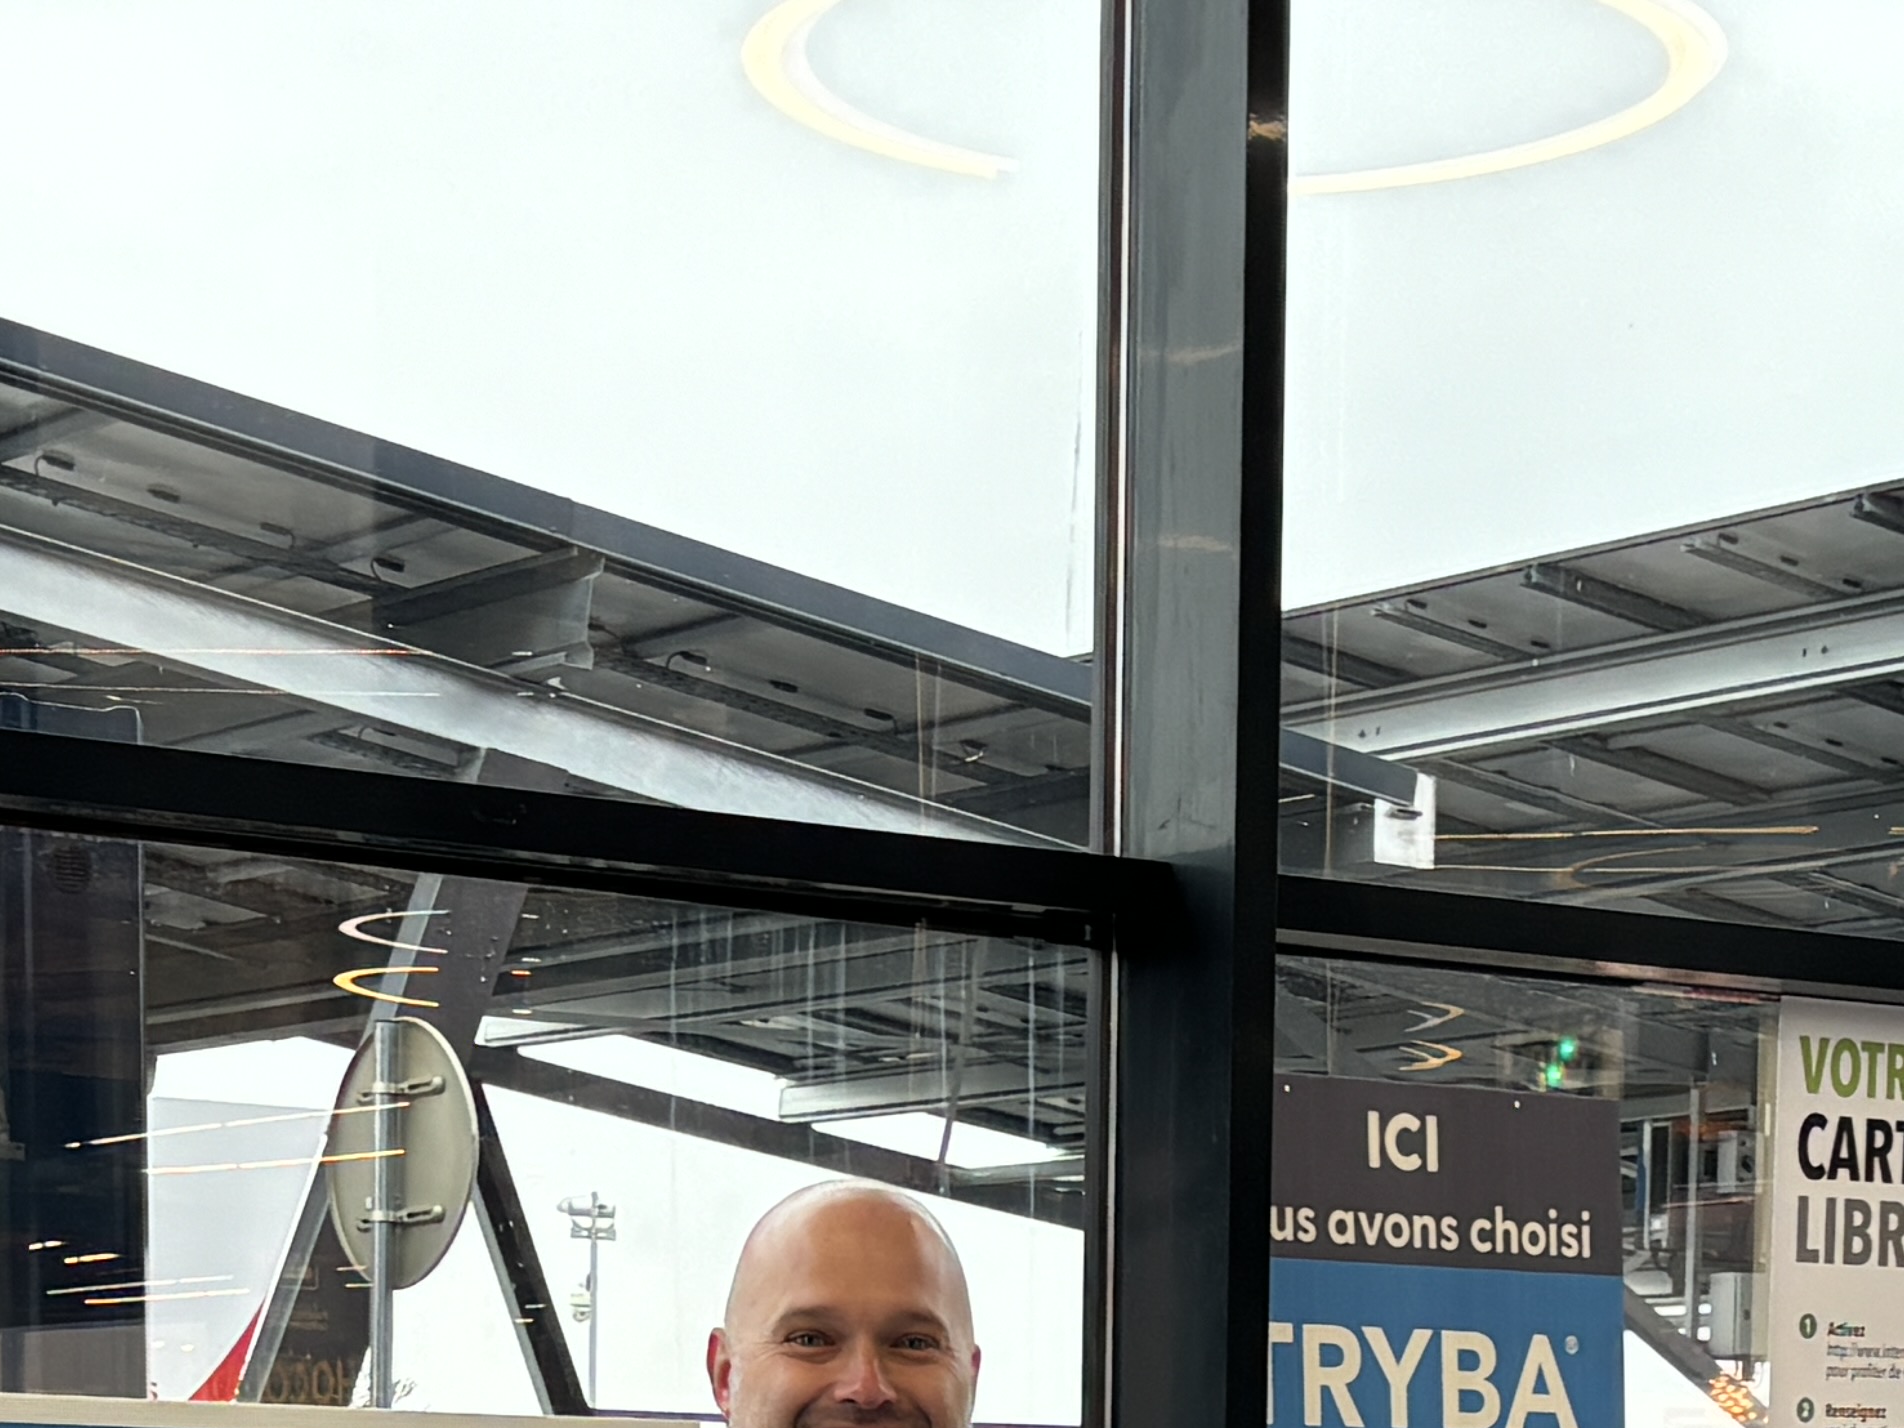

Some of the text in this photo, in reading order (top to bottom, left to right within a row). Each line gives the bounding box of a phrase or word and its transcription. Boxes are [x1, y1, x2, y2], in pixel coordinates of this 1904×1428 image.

[1367, 1110, 1439, 1173] ICI
[1328, 1208, 1459, 1251] avons
[1470, 1206, 1591, 1259] choisi
